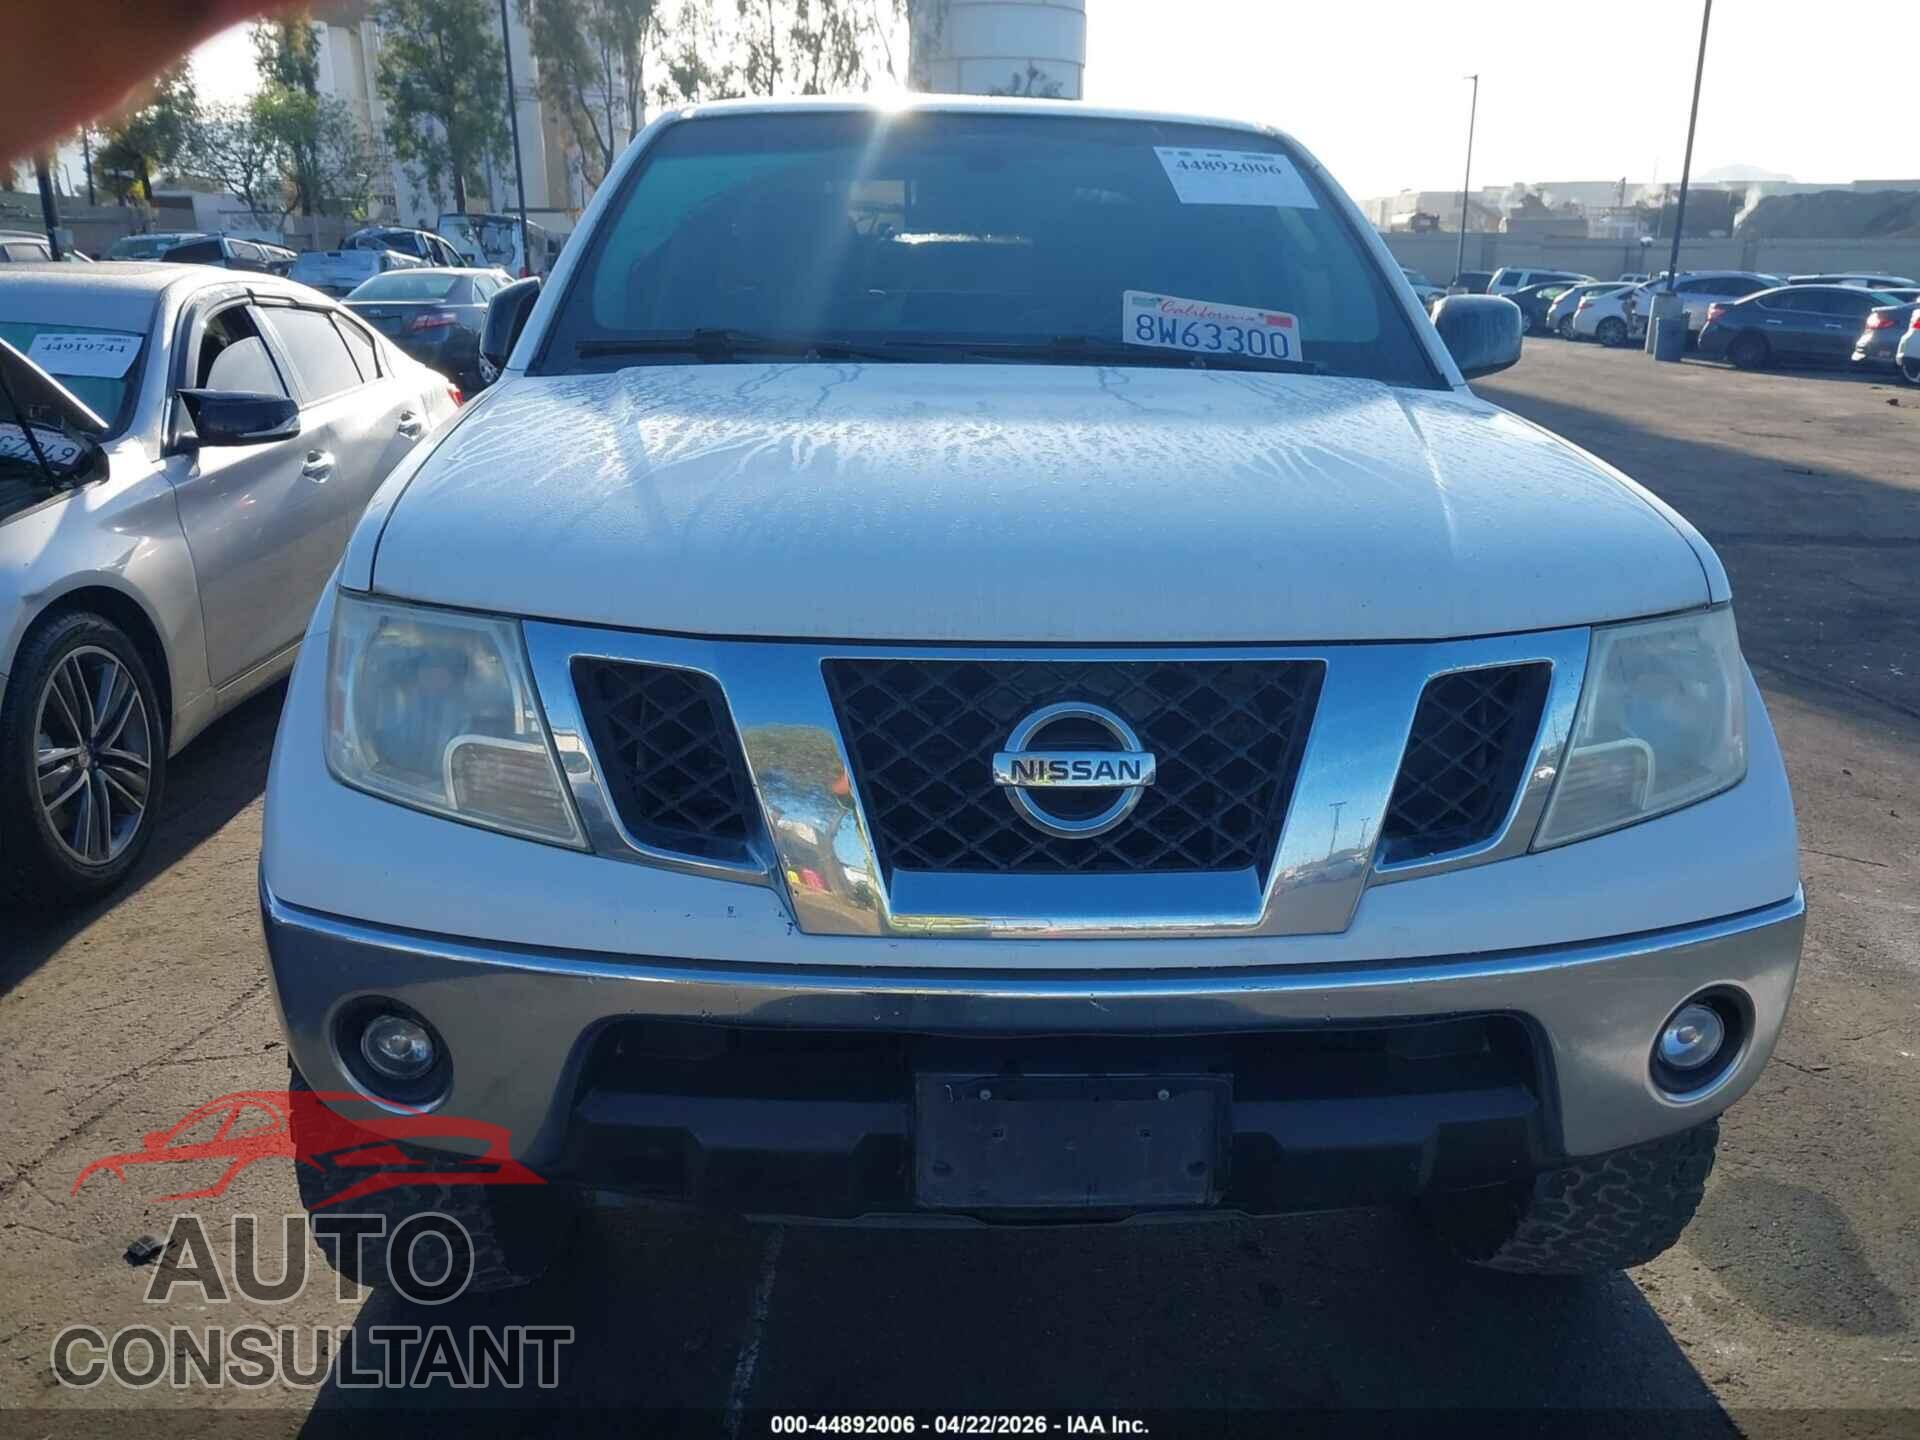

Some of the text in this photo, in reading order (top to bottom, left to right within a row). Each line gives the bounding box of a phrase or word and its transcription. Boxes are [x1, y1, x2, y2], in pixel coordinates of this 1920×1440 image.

[1176, 159, 1281, 175] 44892006
[1136, 314, 1289, 358] 8W63300
[1011, 760, 1141, 781] NISSAN
